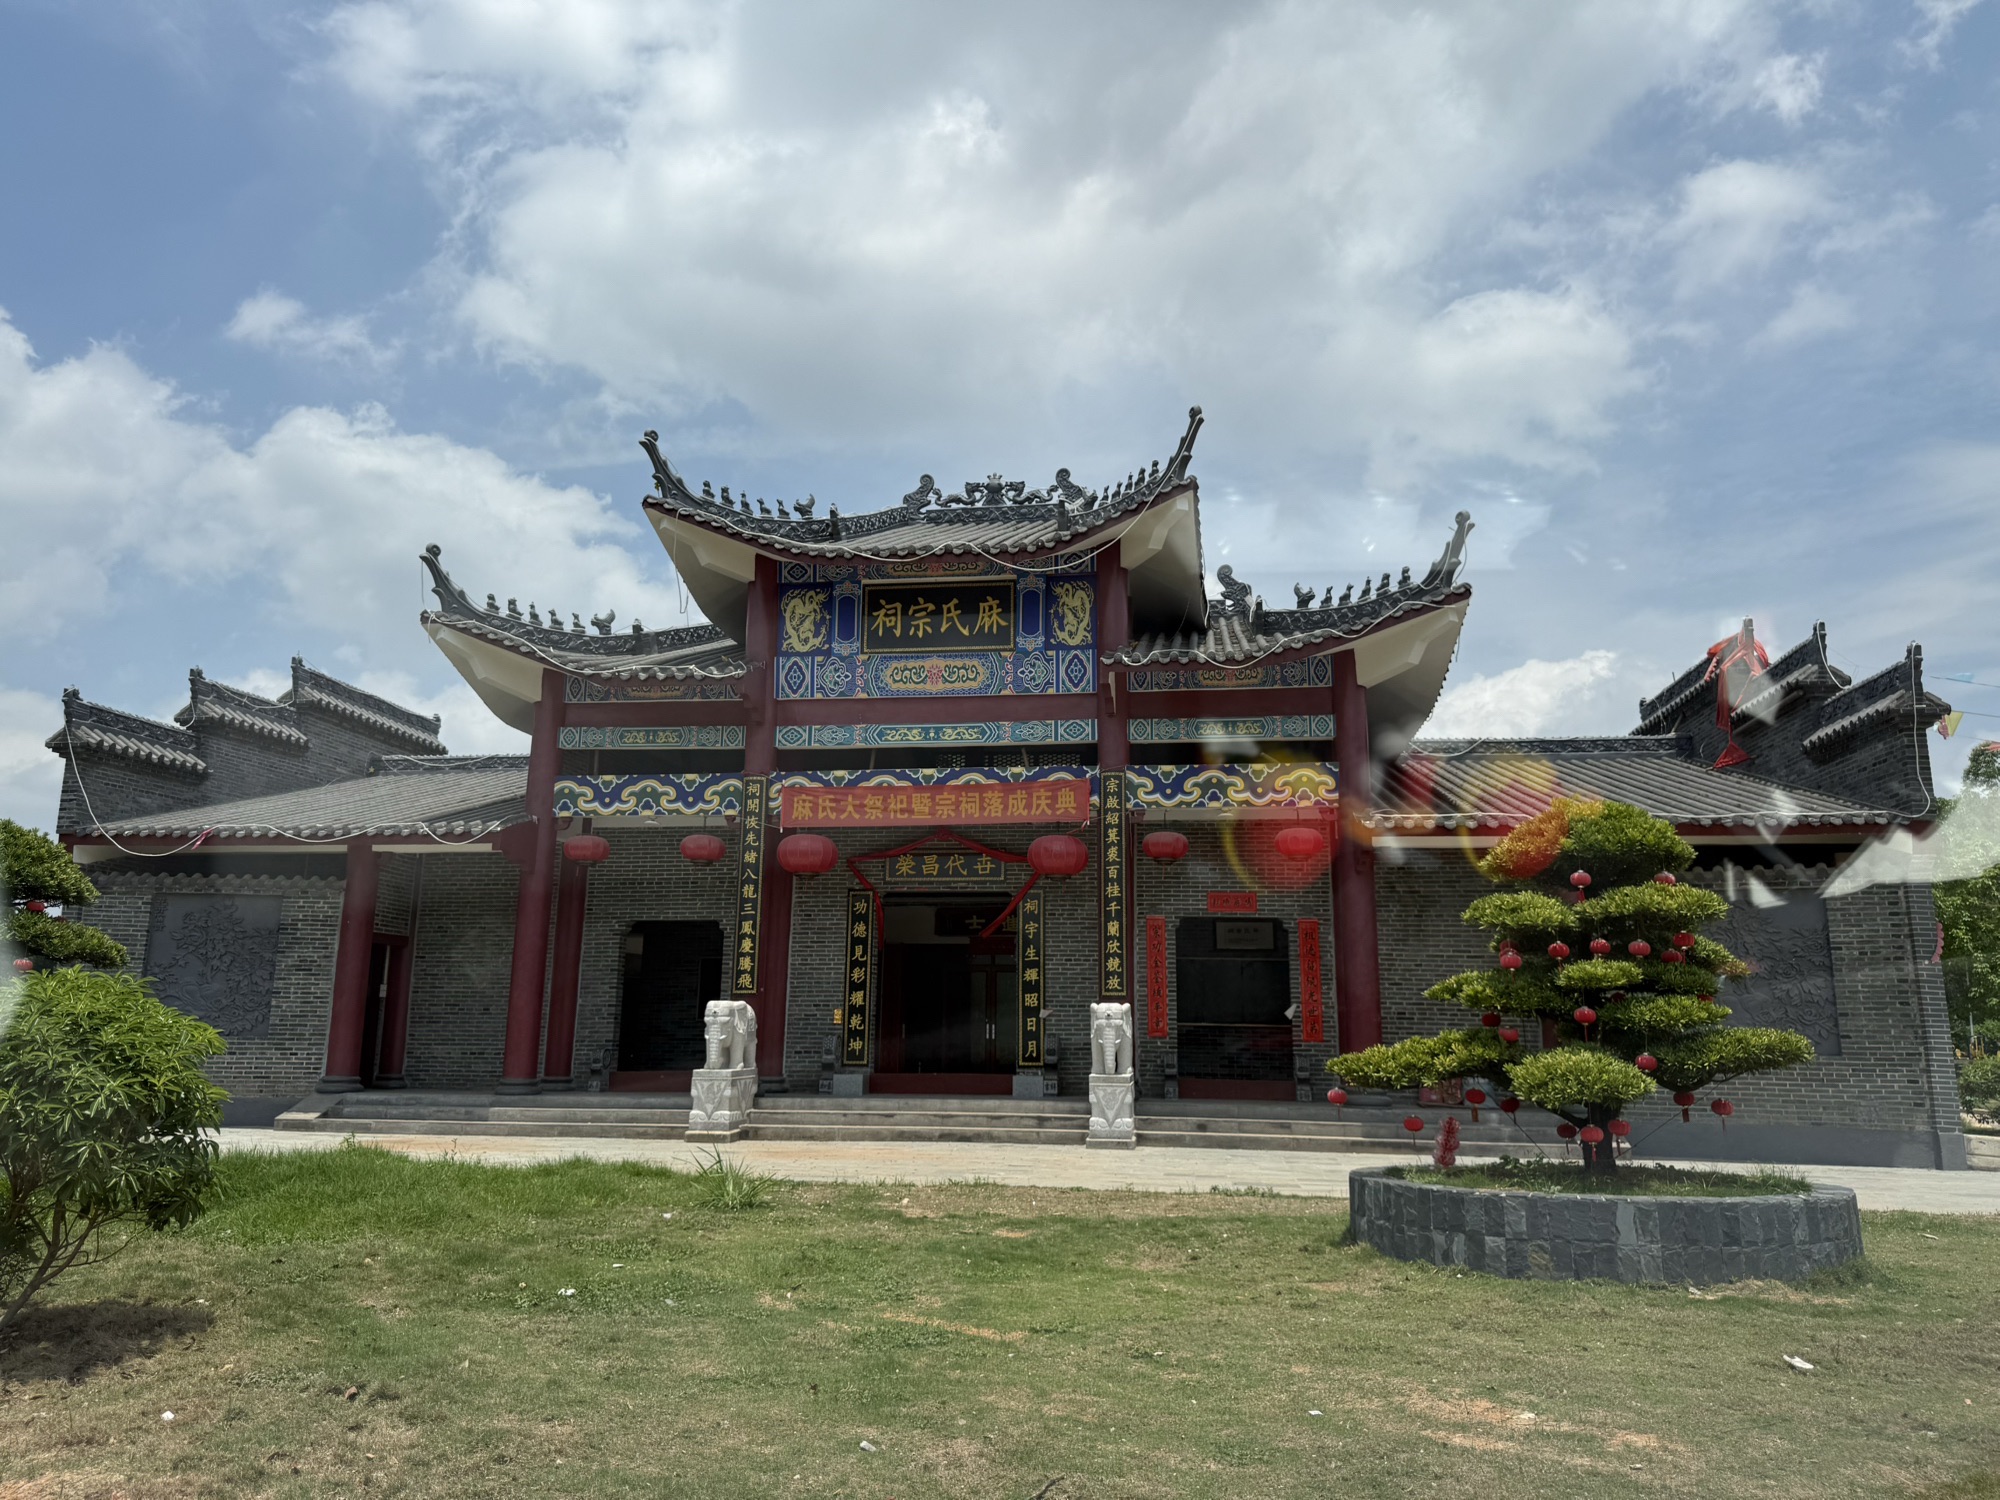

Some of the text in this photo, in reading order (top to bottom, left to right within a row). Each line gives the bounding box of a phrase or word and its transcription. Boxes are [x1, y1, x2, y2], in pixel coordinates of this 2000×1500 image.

[871, 596, 1008, 639] 麻氏宗祠
[792, 787, 1078, 819] 麻氏大祭祀暨宗祠落成庆典
[849, 899, 867, 1056] 功德見彩耀乾坤
[1023, 899, 1040, 1057] 祠宇生輝昭日月
